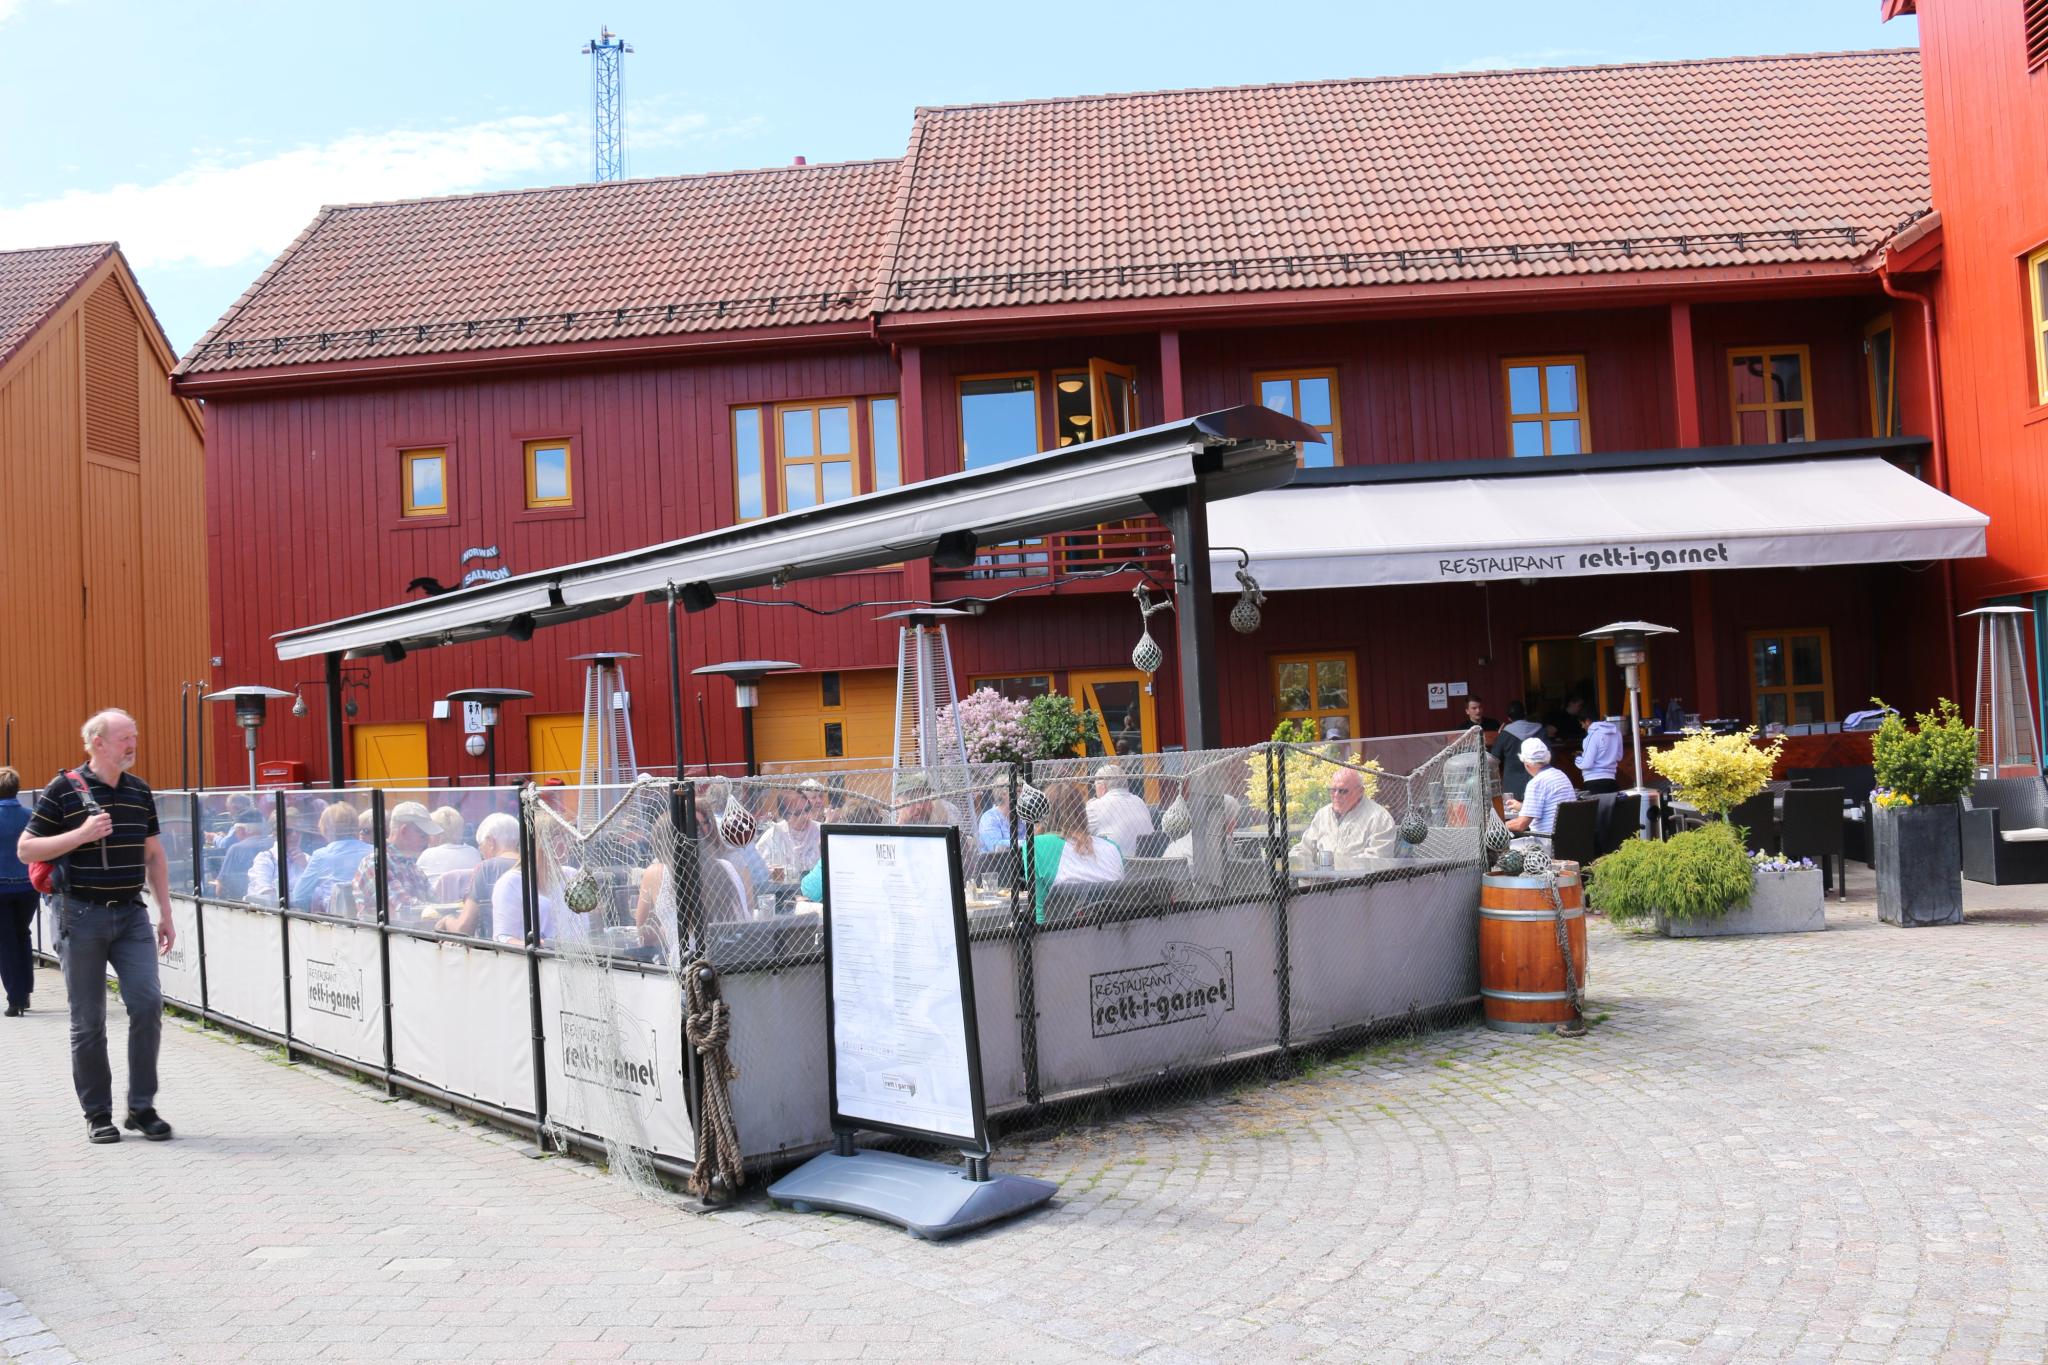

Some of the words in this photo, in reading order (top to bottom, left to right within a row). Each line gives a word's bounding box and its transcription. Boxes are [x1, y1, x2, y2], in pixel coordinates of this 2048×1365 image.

[463, 545, 497, 561] NORWAY
[1440, 555, 1565, 575] RESTAURANT
[1579, 543, 1728, 571] rett-i-garnet
[465, 567, 509, 585] SALMON
[875, 843, 897, 860] MENY
[309, 983, 360, 1012] rett-i-garnet
[1094, 972, 1174, 999] RESTAURANT
[1096, 978, 1227, 1027] rett-i-garnet
